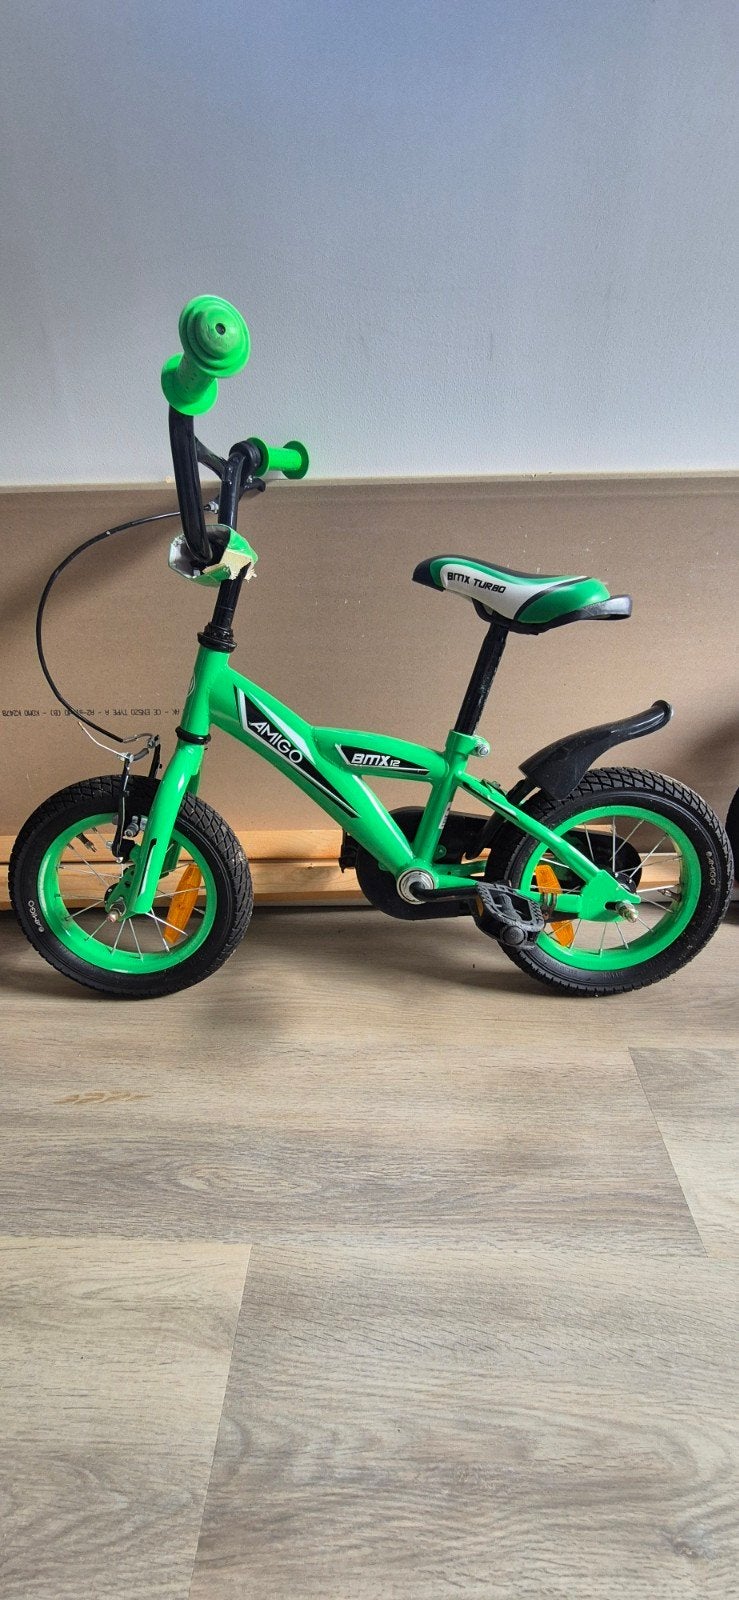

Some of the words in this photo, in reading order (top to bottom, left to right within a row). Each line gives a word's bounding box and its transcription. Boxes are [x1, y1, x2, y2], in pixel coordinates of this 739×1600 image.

[447, 571, 470, 584] BMX
[473, 578, 507, 594] TURBO
[248, 721, 303, 764] AMIGO
[350, 753, 391, 767] BMX
[390, 759, 401, 767] 12
[707, 857, 717, 886] AMIGO
[28, 900, 42, 927] AMIGO
